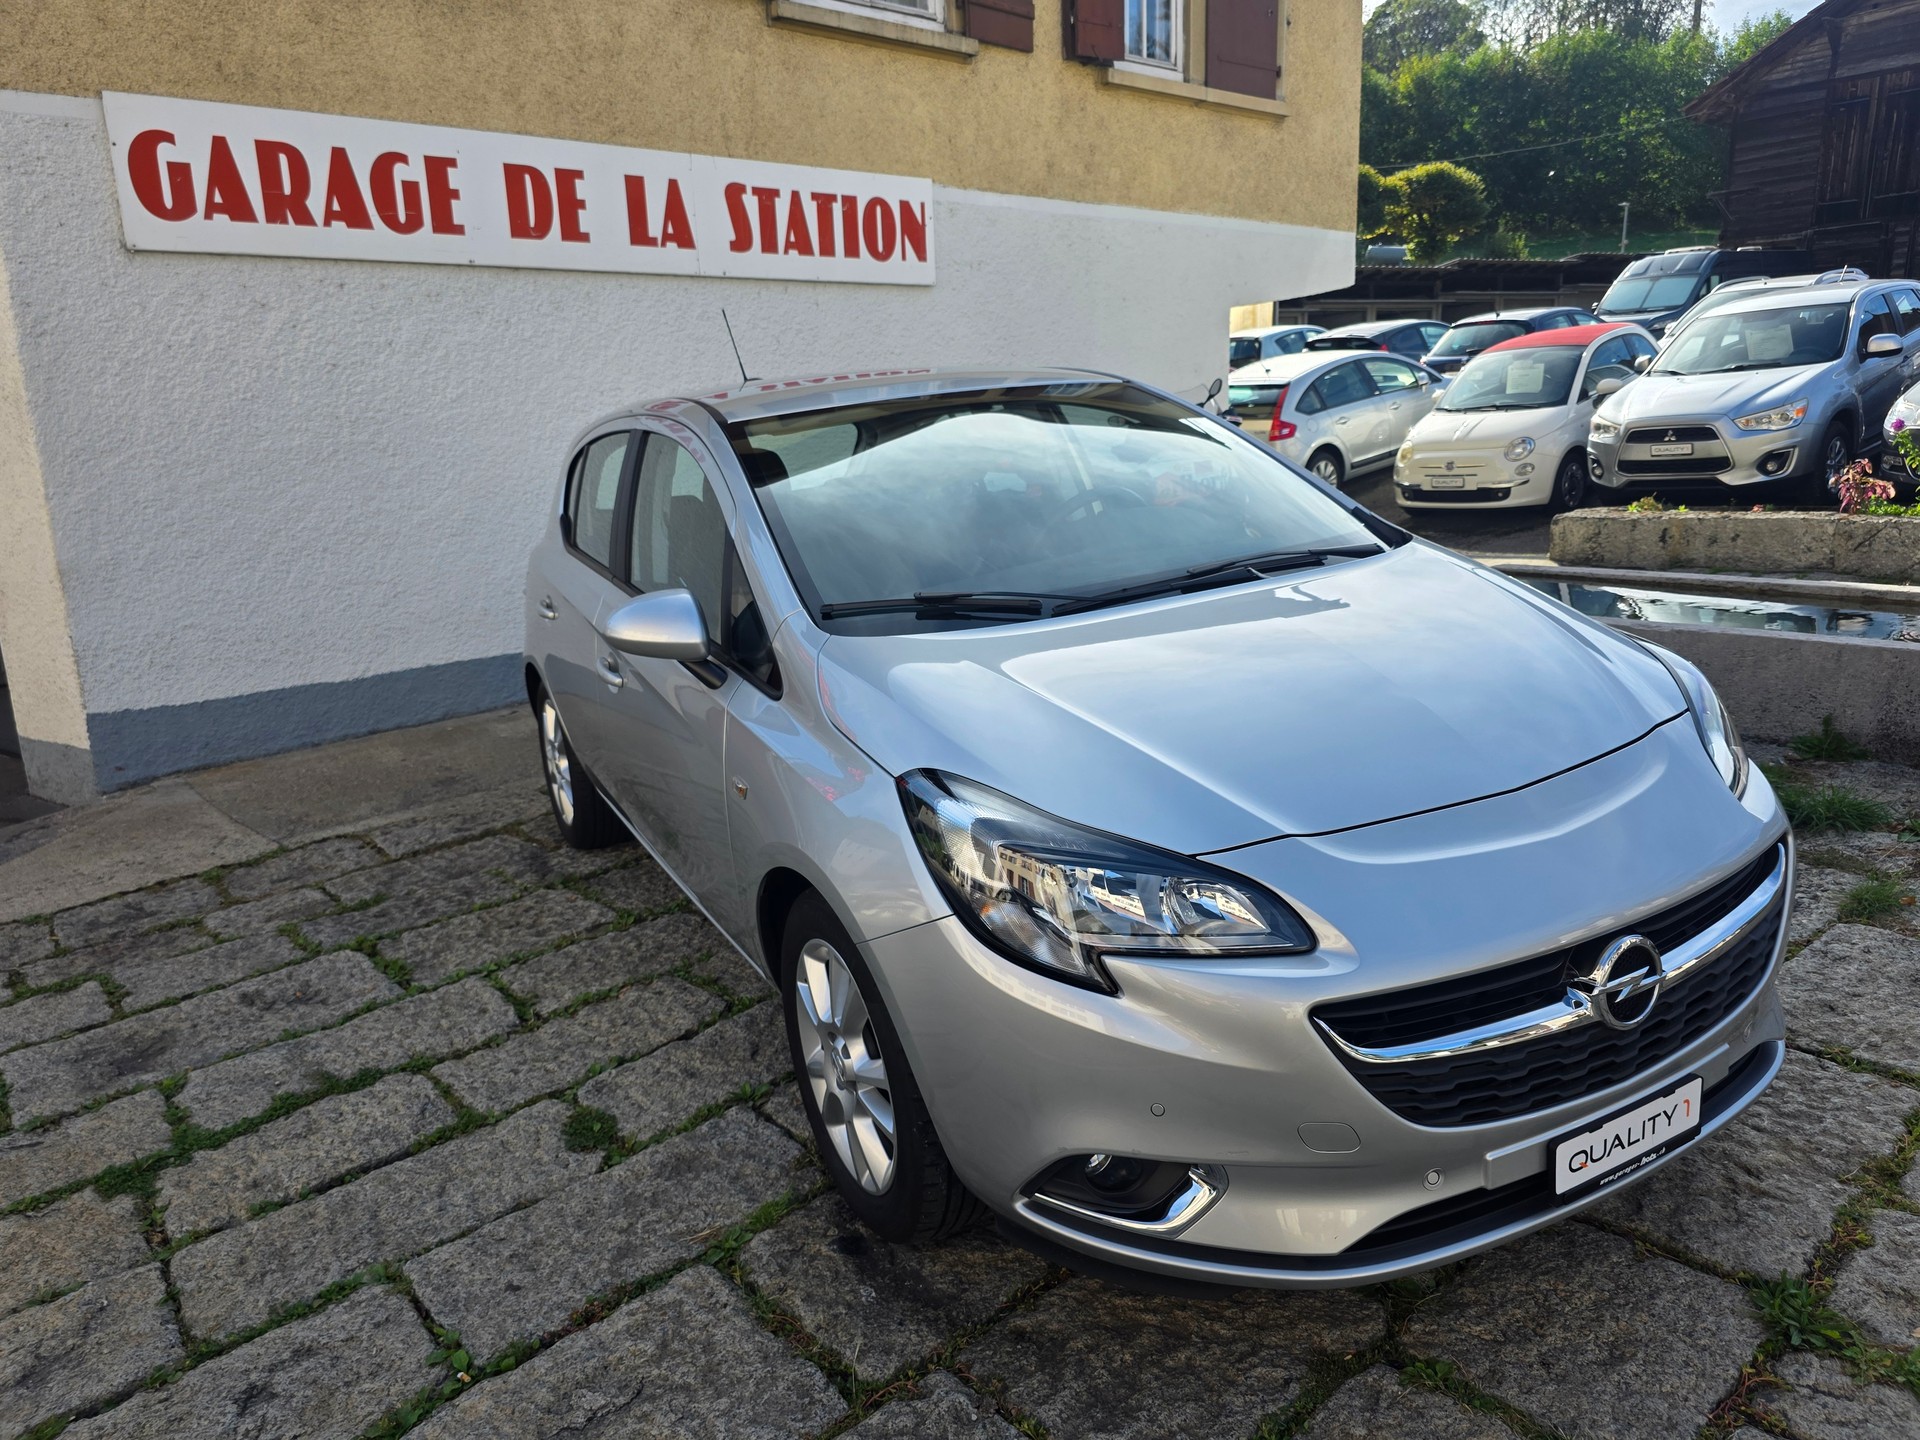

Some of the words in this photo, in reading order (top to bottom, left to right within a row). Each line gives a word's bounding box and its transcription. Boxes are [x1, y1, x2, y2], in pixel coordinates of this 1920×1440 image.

[127, 129, 465, 234] GARAGE
[503, 164, 589, 242] DE
[625, 175, 695, 248] LA
[725, 183, 926, 263] STATION
[1568, 1103, 1679, 1173] QUALITY
[1683, 1098, 1691, 1118] 1
